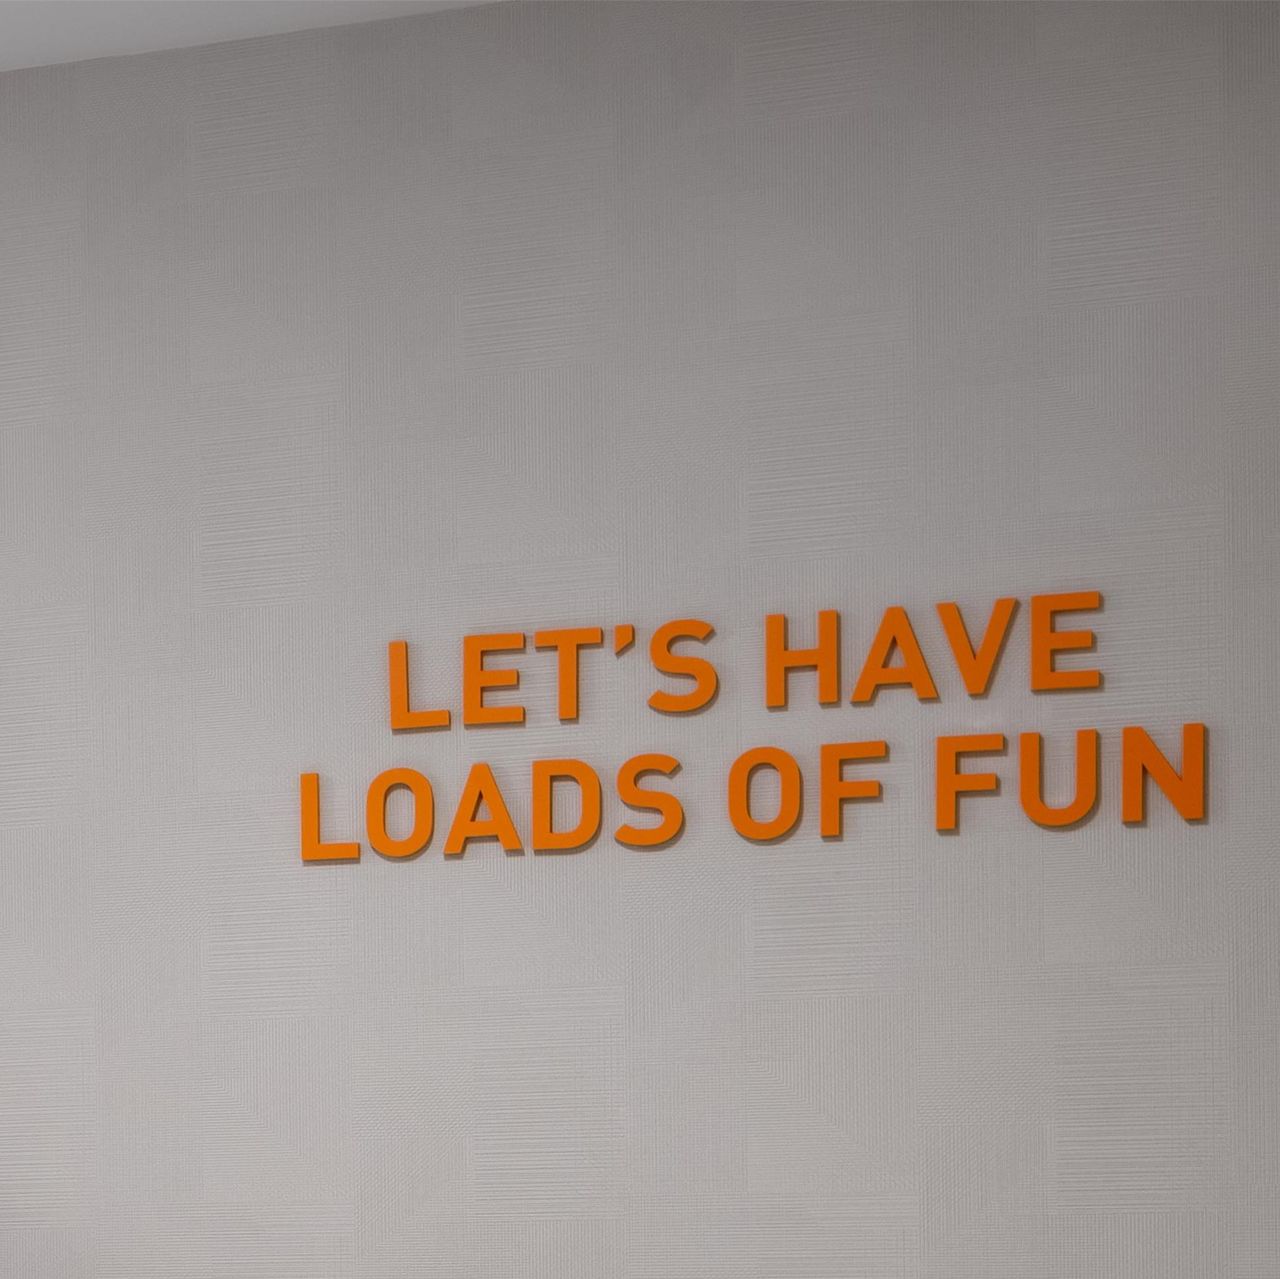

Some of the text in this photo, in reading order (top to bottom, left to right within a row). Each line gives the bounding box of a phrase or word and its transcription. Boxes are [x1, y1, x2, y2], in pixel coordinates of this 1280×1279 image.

[387, 591, 1103, 731] LET'S HAVE
[300, 722, 1208, 863] LOADS OF FUN
